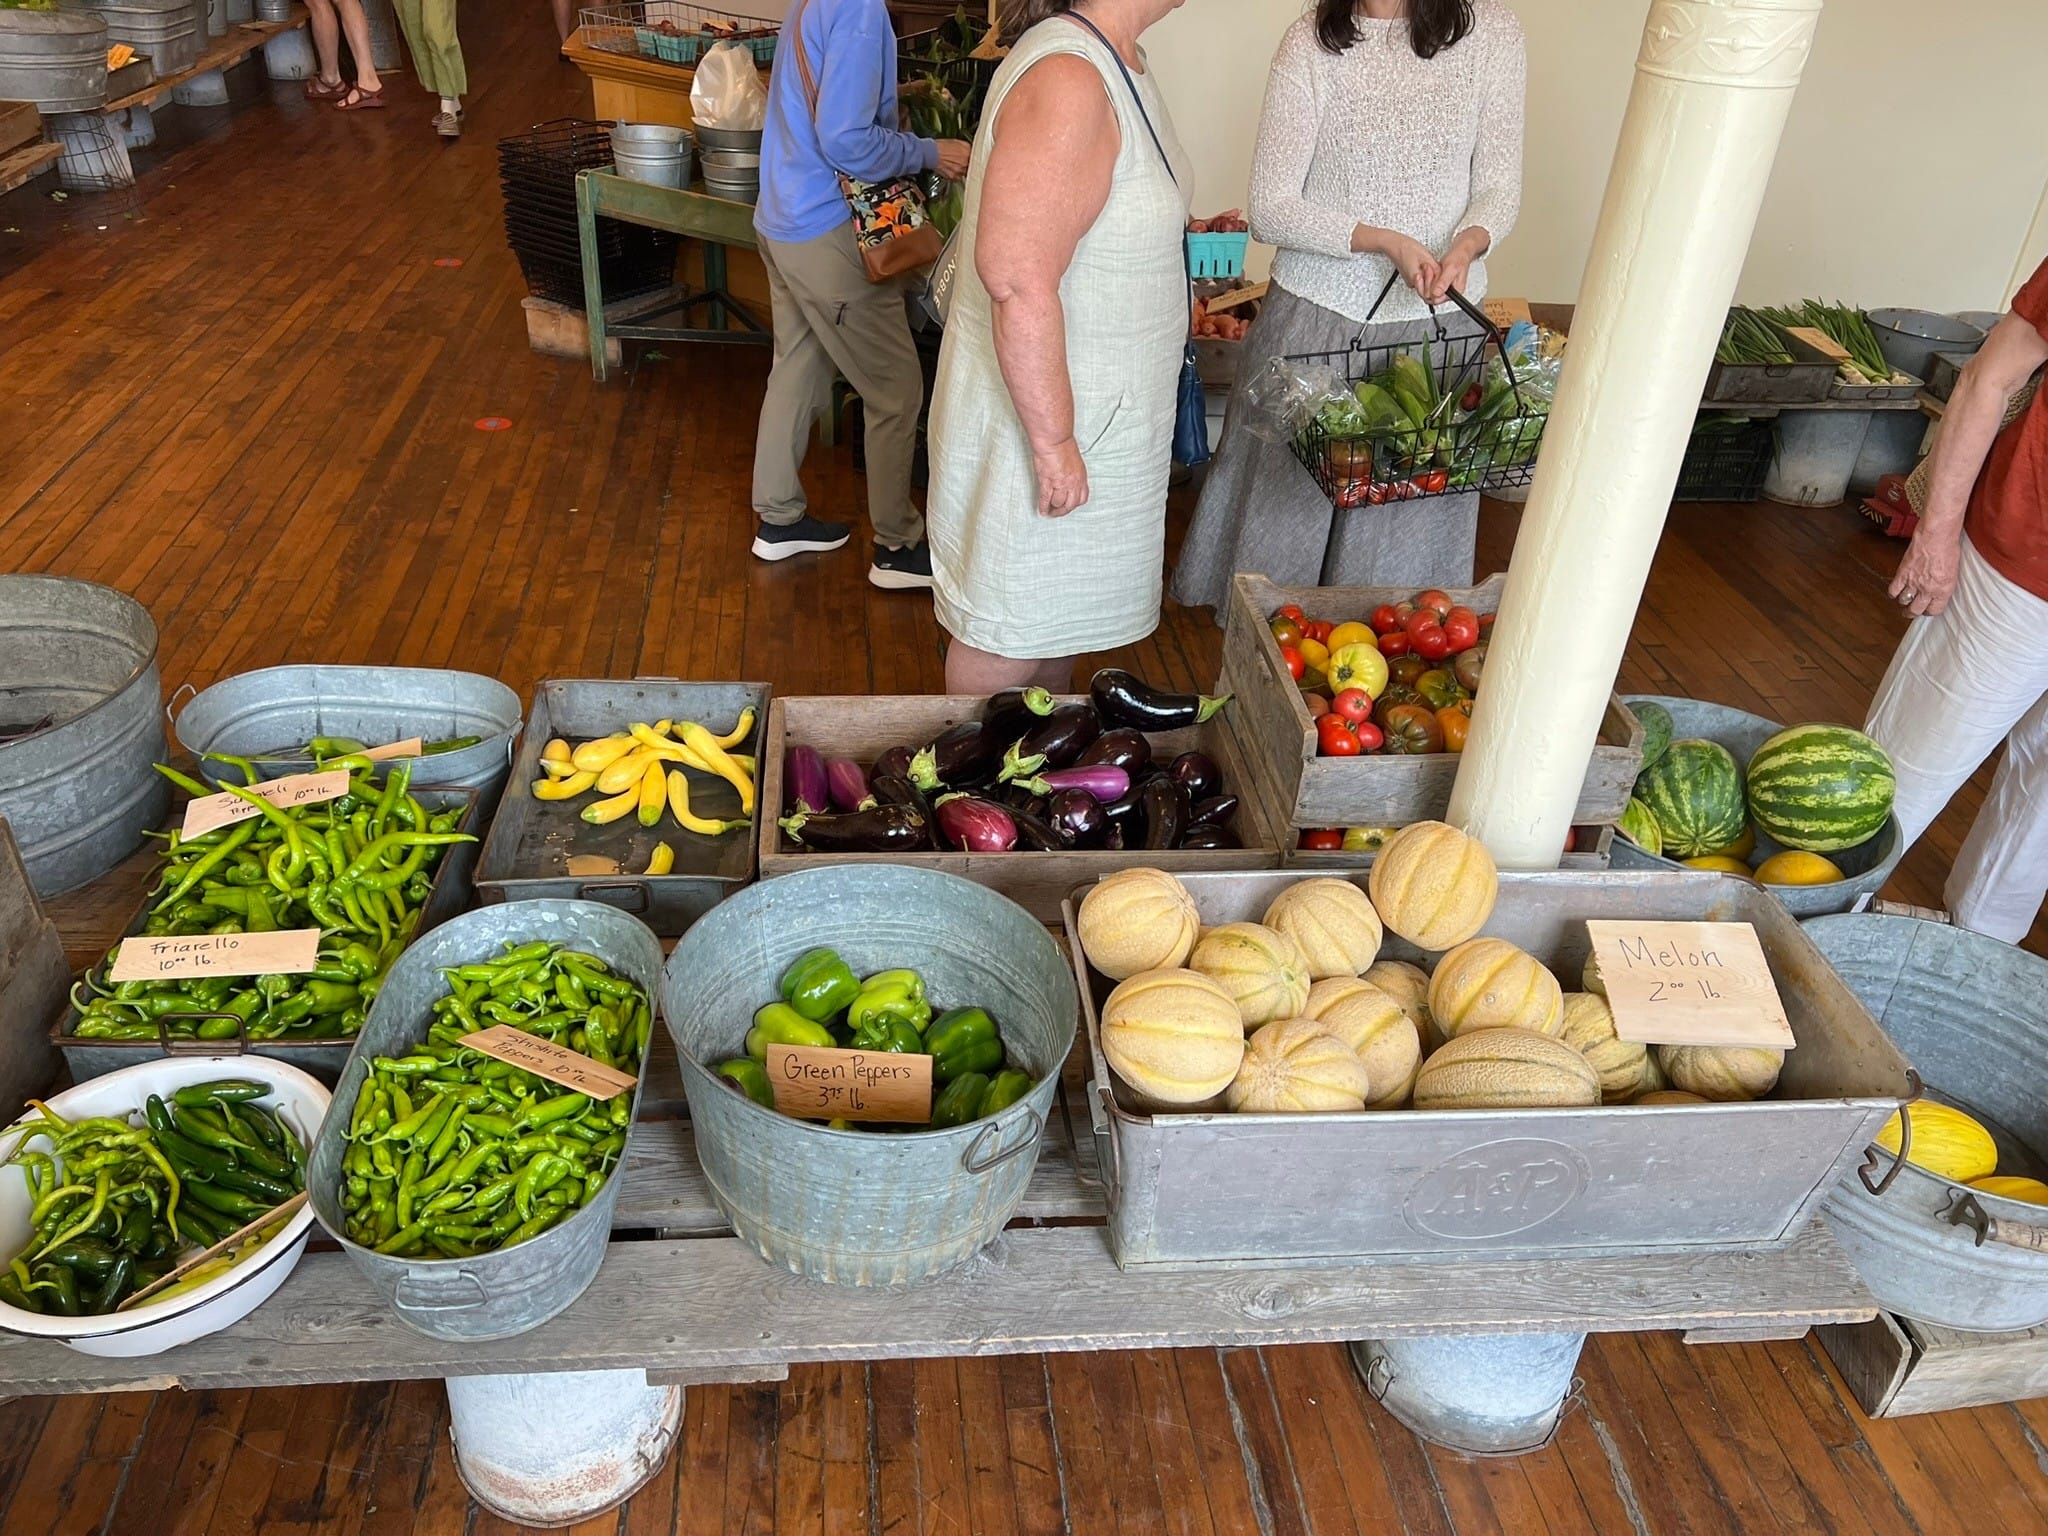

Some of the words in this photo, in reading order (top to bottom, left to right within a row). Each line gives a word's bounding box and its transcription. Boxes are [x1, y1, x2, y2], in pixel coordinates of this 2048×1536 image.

[933, 259, 956, 309] NOBLE
[150, 937, 239, 955] Friarello
[1618, 936, 1724, 969] Melon
[493, 1042, 544, 1065] Peppers
[783, 1053, 846, 1080] Green
[850, 1054, 912, 1088] Peppers
[1423, 1158, 1571, 1215] A&P
